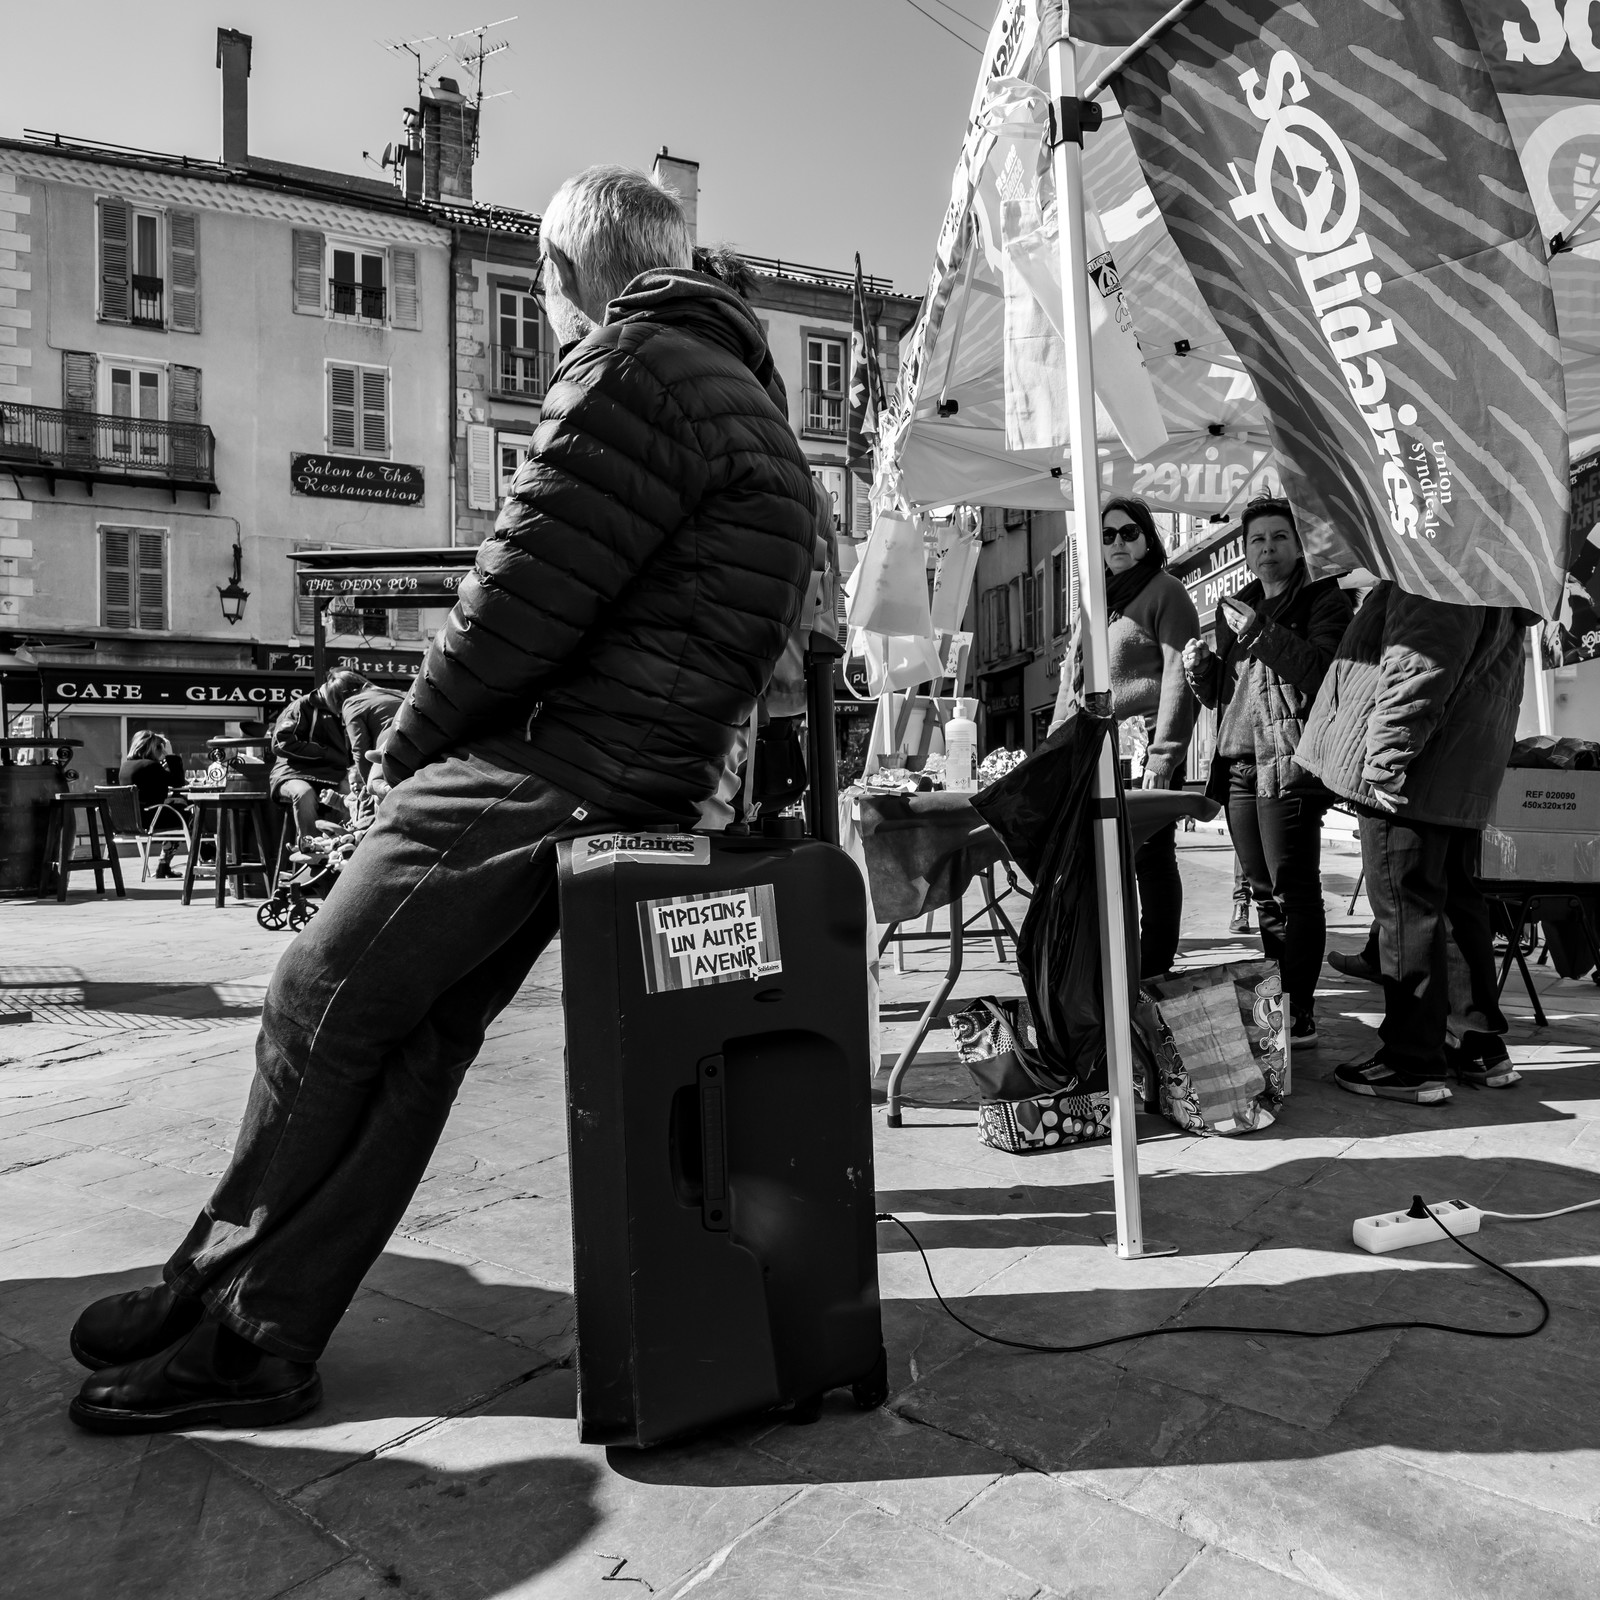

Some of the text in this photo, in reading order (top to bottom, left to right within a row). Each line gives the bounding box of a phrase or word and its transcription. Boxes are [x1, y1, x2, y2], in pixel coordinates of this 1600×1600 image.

[1228, 49, 1419, 541] Solidaires
[303, 458, 412, 483] Salon de Thé
[1432, 439, 1453, 505] Union
[297, 475, 420, 500] Restauration
[1408, 442, 1440, 539] syndicale
[1209, 535, 1245, 573] MAI
[306, 577, 462, 591] THE DED'S PUB BA
[1204, 562, 1259, 606] PAPETER
[292, 653, 420, 674] L Bretze
[853, 673, 868, 684] PU
[56, 682, 142, 699] CAFE
[185, 686, 304, 702] GLACES
[1522, 801, 1577, 811] 450x320x120
[1525, 790, 1576, 800] REF 020090
[587, 835, 695, 857] Solidaires
[671, 921, 757, 954] UN AUTRE
